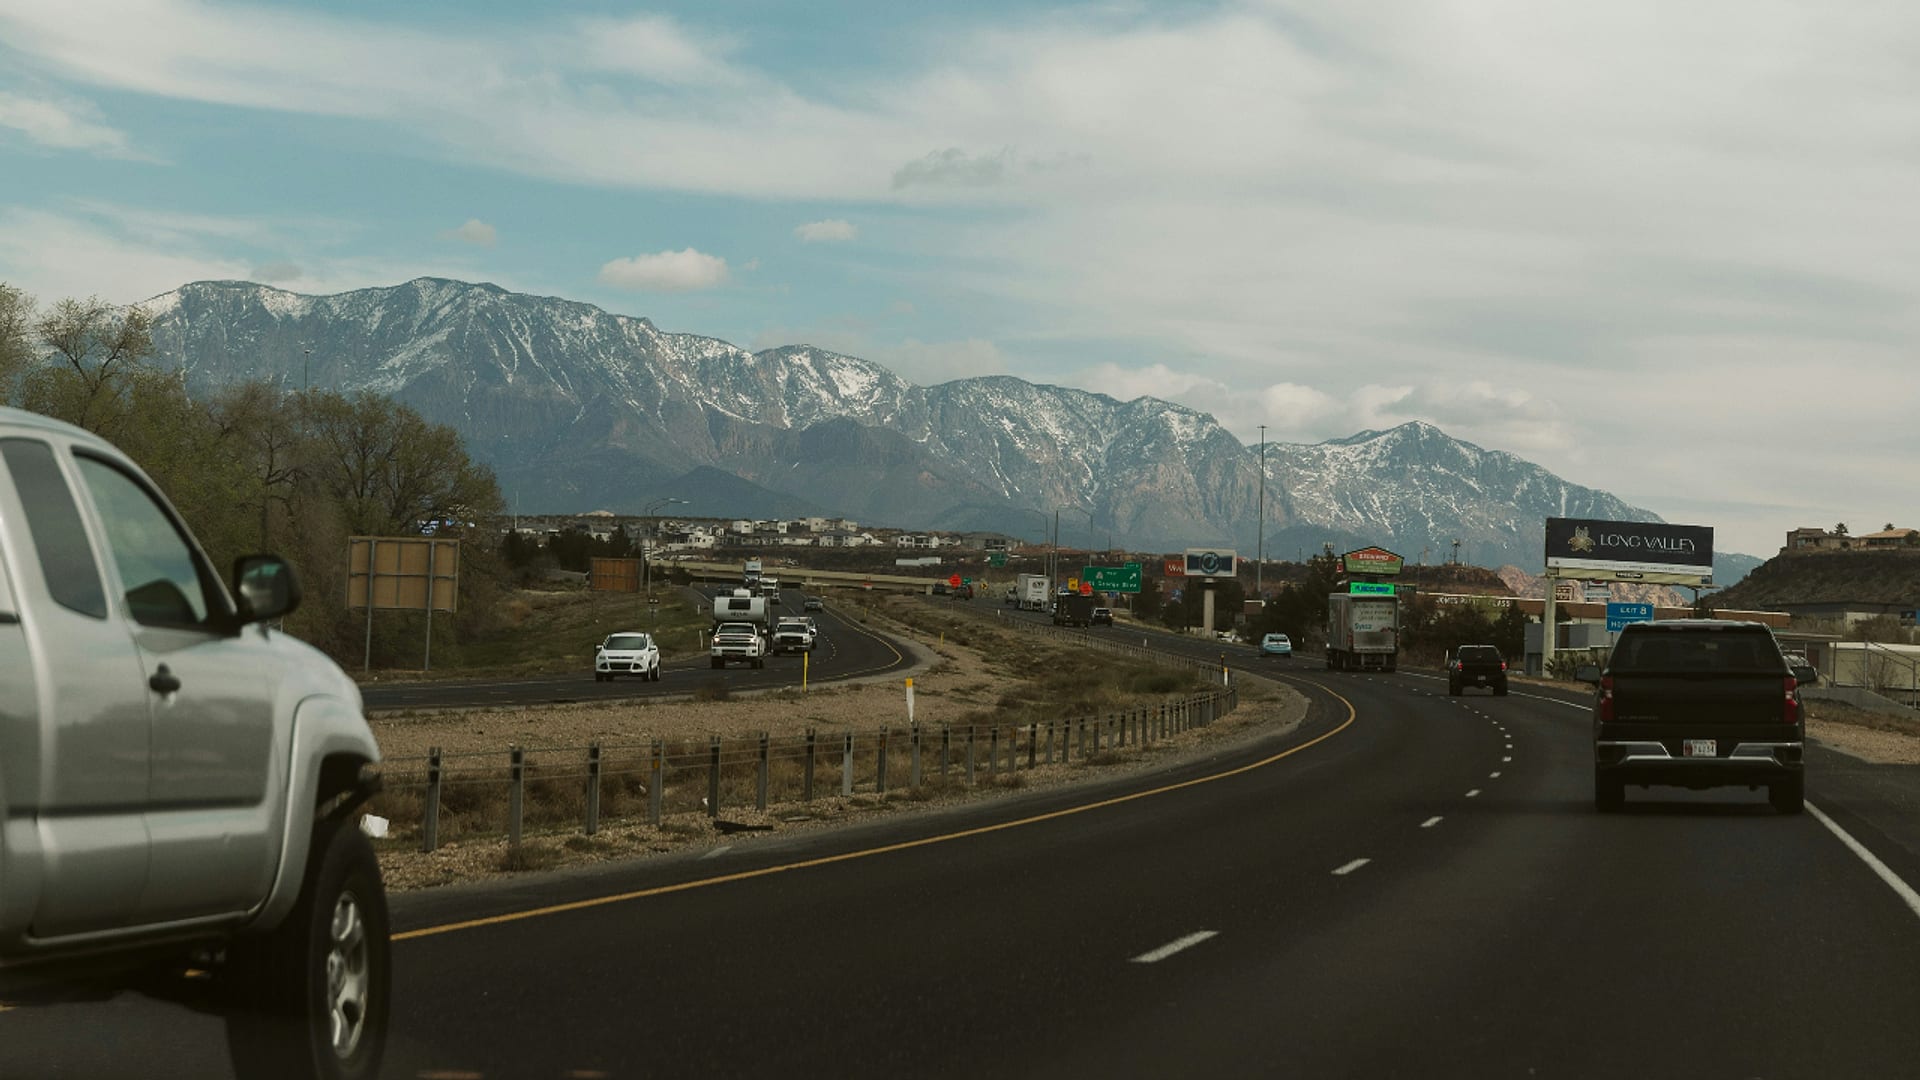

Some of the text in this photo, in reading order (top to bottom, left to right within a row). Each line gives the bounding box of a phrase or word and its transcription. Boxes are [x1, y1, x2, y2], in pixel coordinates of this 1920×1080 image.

[1600, 533, 1695, 551] LONG VALLEY
[1640, 607, 1647, 615] 8
